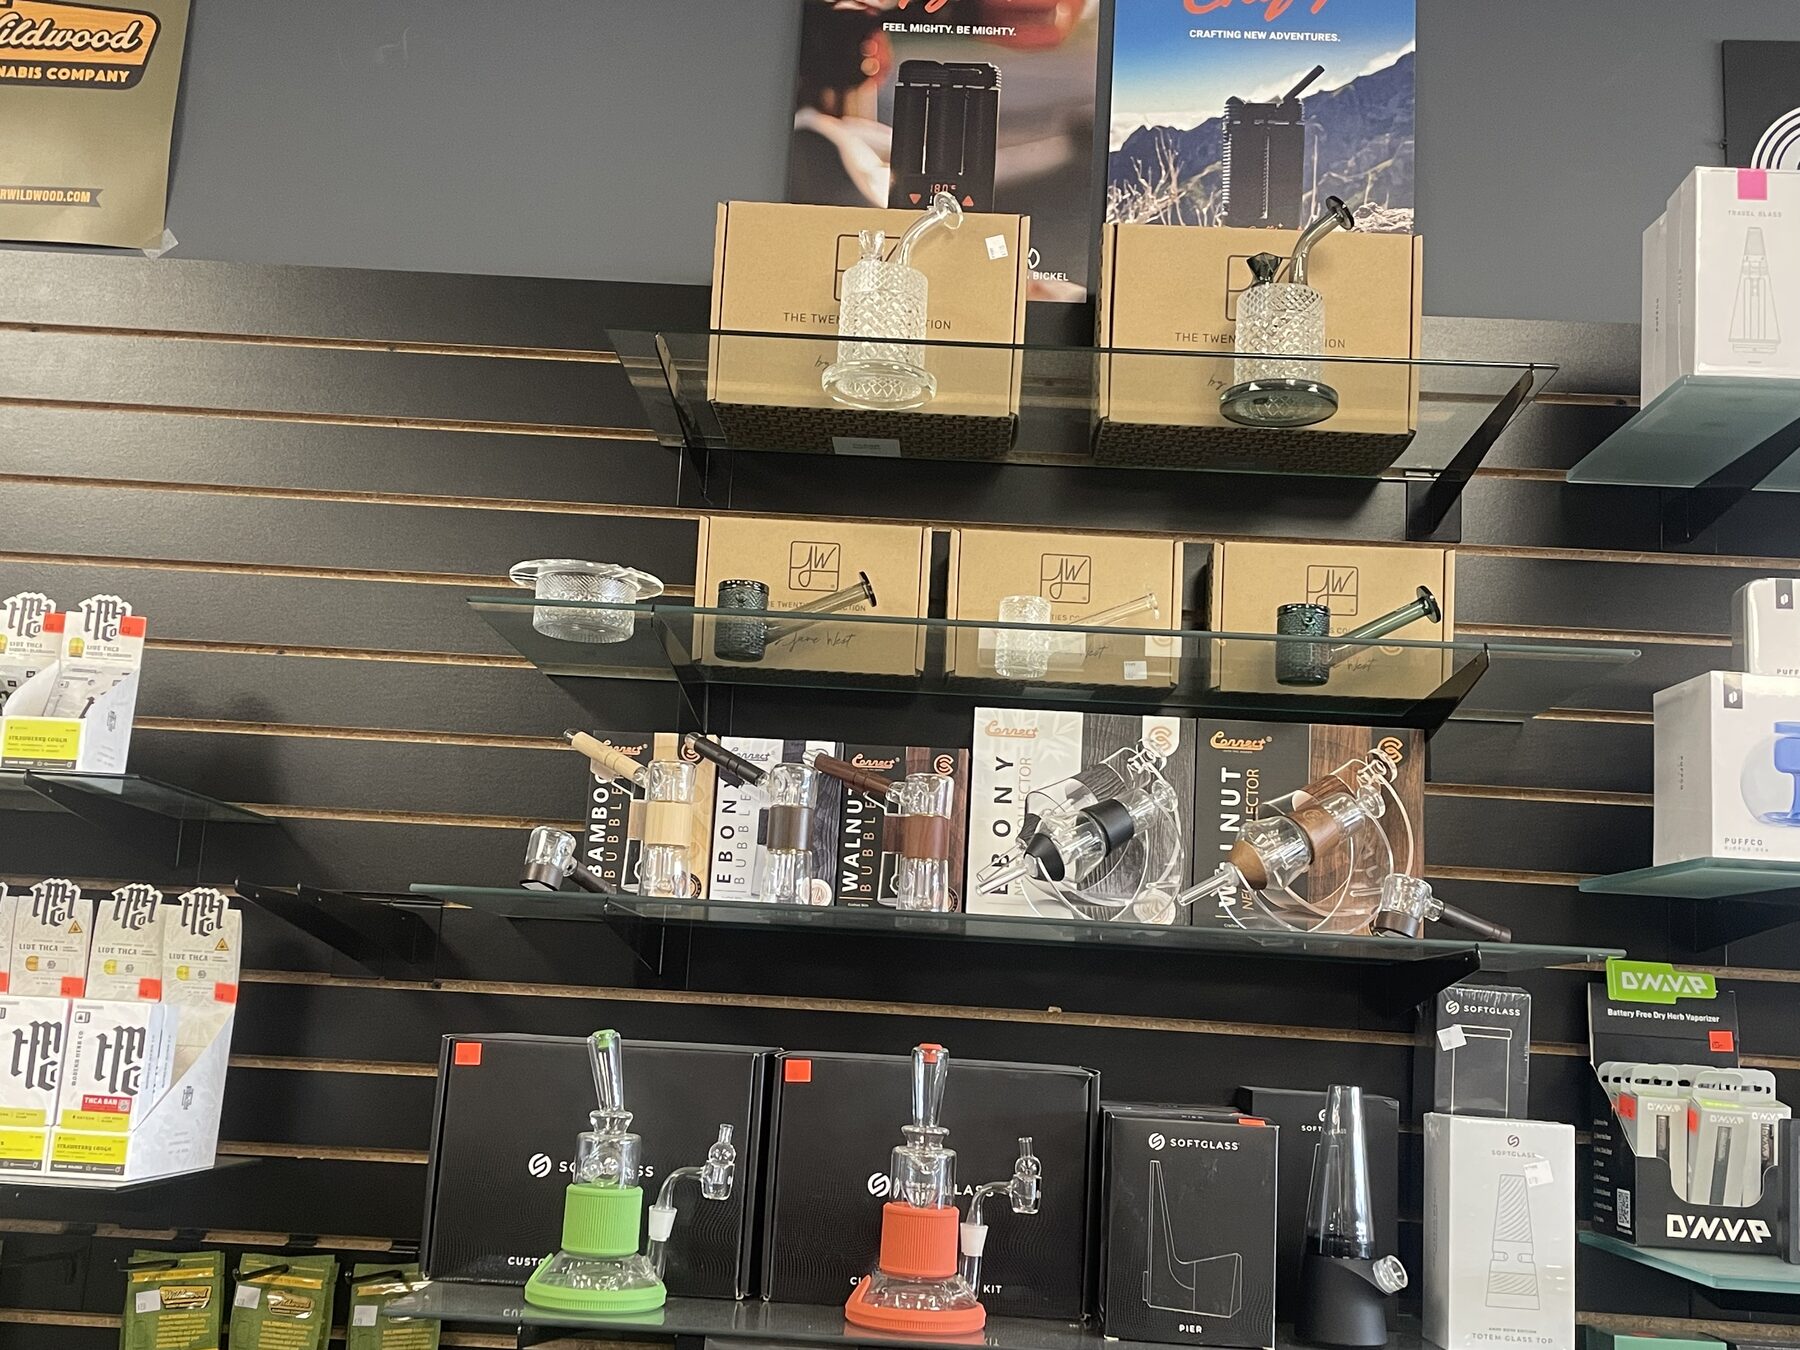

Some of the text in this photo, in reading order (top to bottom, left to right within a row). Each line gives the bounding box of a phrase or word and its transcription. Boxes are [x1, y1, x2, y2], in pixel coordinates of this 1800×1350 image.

[0, 11, 141, 51] ildwood
[883, 22, 1017, 37] FEEL MIGHTY. BE MIGHTY.
[1189, 29, 1341, 42] CRAFTING NEW ADVENTURES.
[46, 67, 130, 83] COMPANY
[1033, 271, 1069, 282] BICKEL
[784, 312, 806, 323] THE
[1175, 332, 1198, 342] THE
[984, 720, 1039, 739] Connect
[1210, 731, 1266, 750] Connect
[851, 753, 895, 769] Connect
[604, 776, 624, 878] BUBBLE
[734, 780, 751, 885] BUBBLE
[989, 756, 1014, 895] EBONY
[1218, 766, 1242, 908] WNUT
[1724, 837, 1763, 846] PUFFCO
[1463, 1004, 1521, 1017] SOFTGLASS
[1607, 1008, 1720, 1023] Battery Free Dry Herb Vaporizer
[1169, 1137, 1240, 1151] SOFTGLASS
[1491, 1149, 1537, 1159] SOFTGLASS
[983, 1284, 1003, 1294] KIT
[1178, 1323, 1203, 1335] PIER
